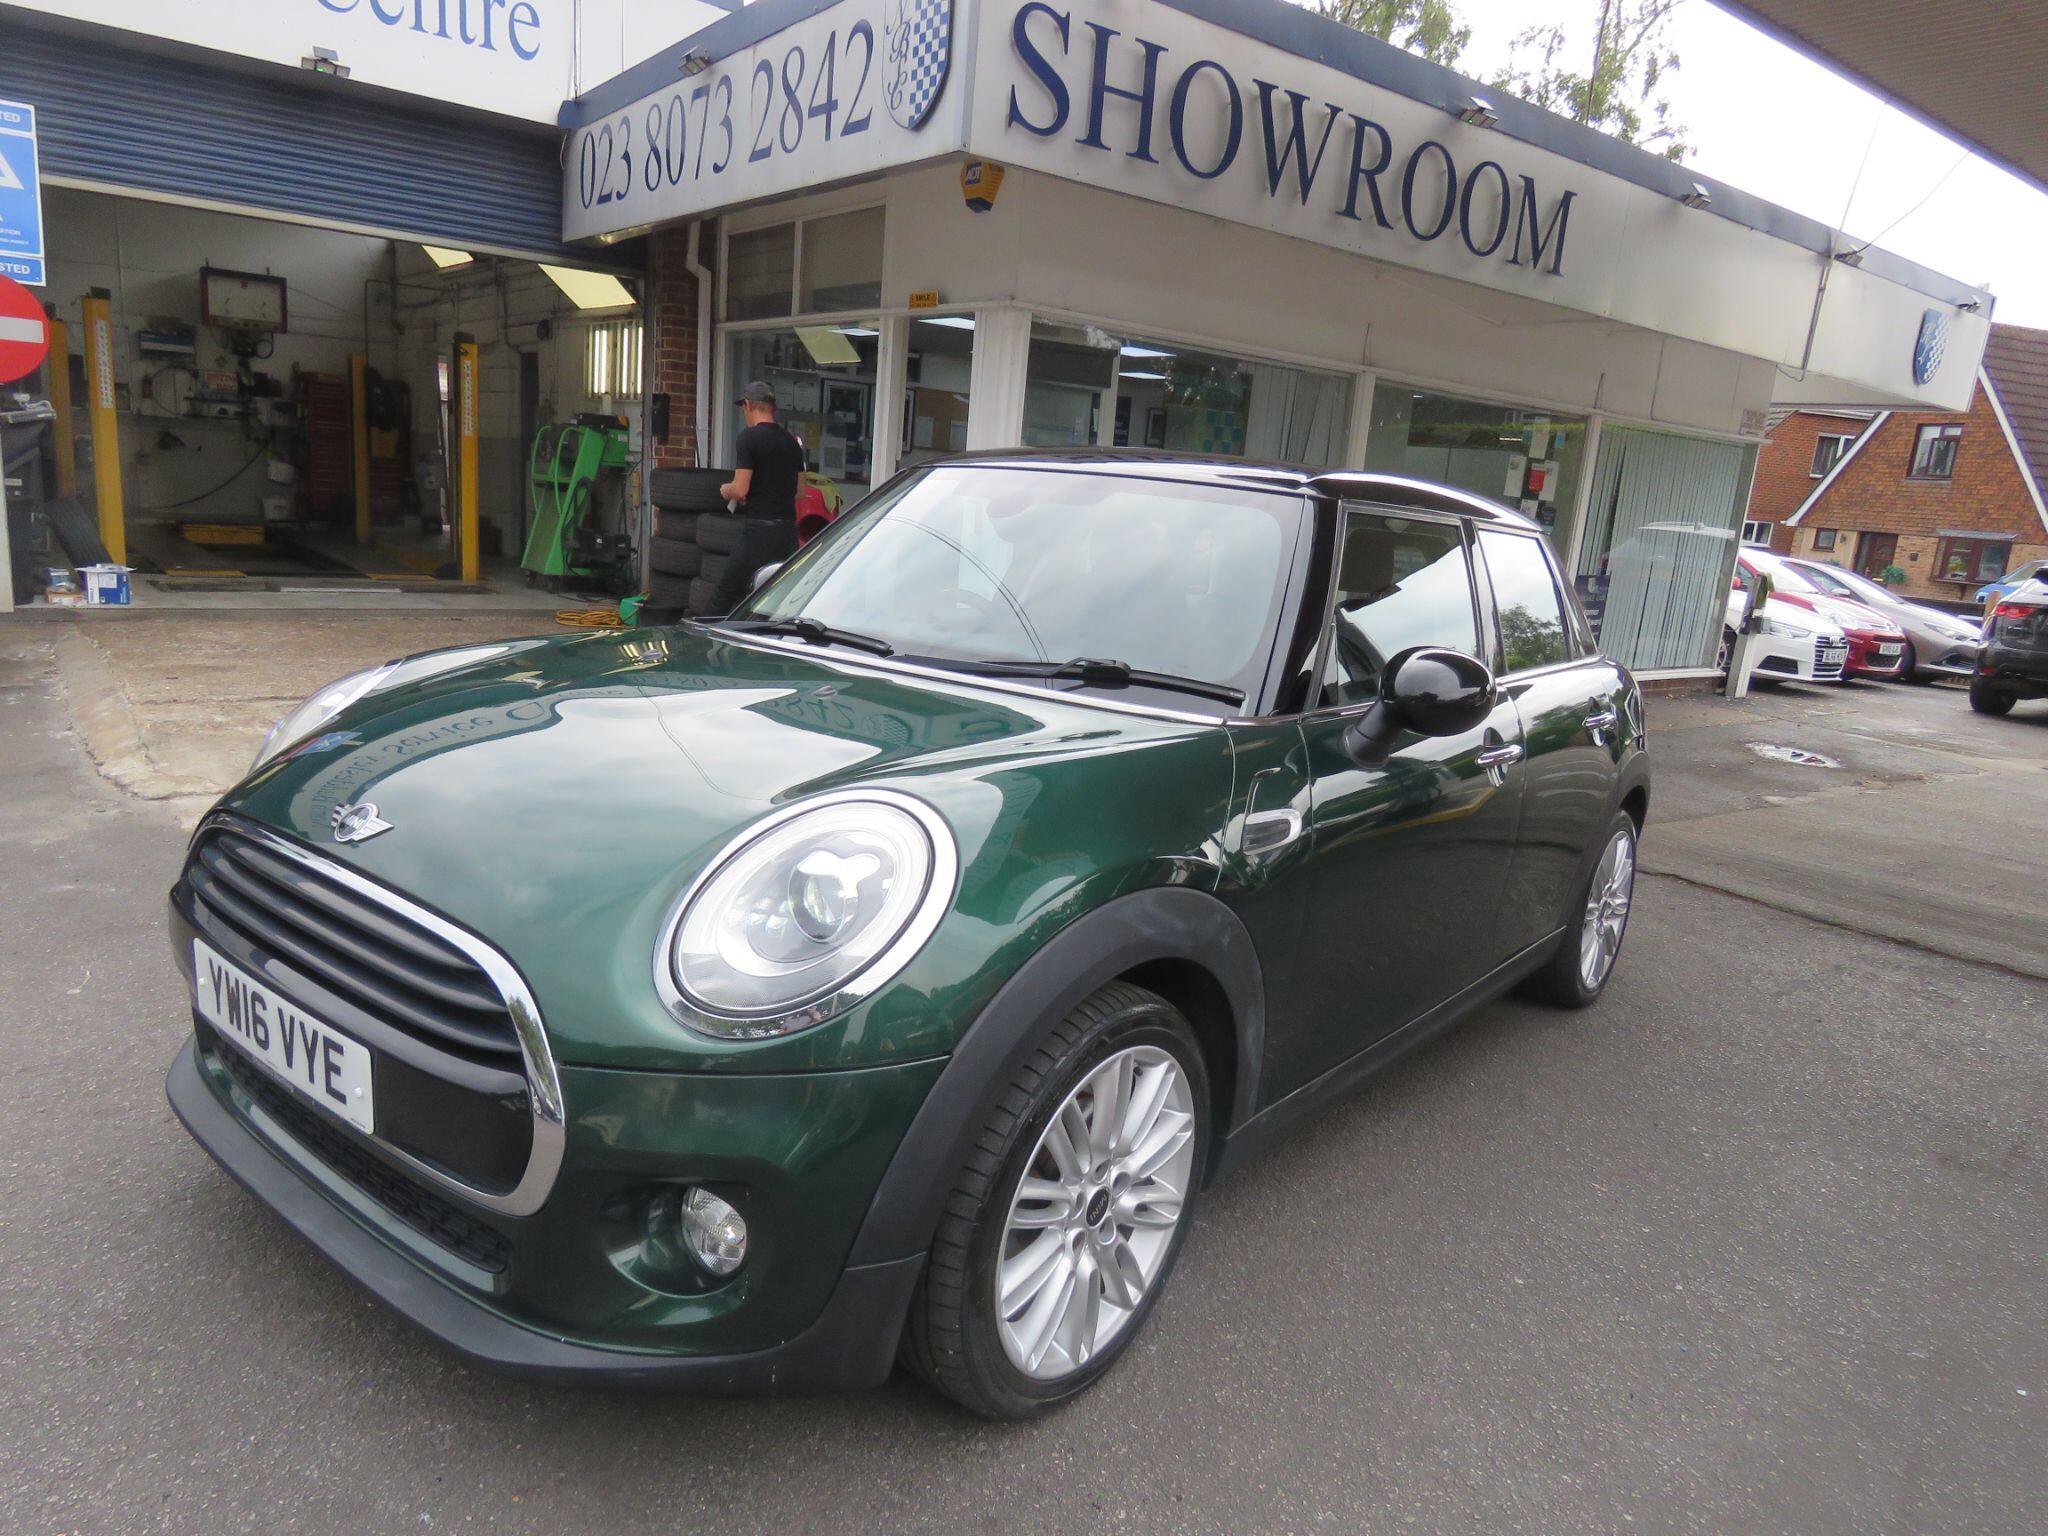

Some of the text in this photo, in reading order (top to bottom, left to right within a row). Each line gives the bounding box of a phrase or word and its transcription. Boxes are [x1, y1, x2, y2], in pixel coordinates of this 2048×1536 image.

[317, 0, 541, 61] ntre
[580, 19, 874, 209] 023 8073 2842
[966, 166, 982, 179] ADT
[1008, 2, 1578, 277] SHOWROOM
[208, 957, 347, 1105] YW16 VYE
